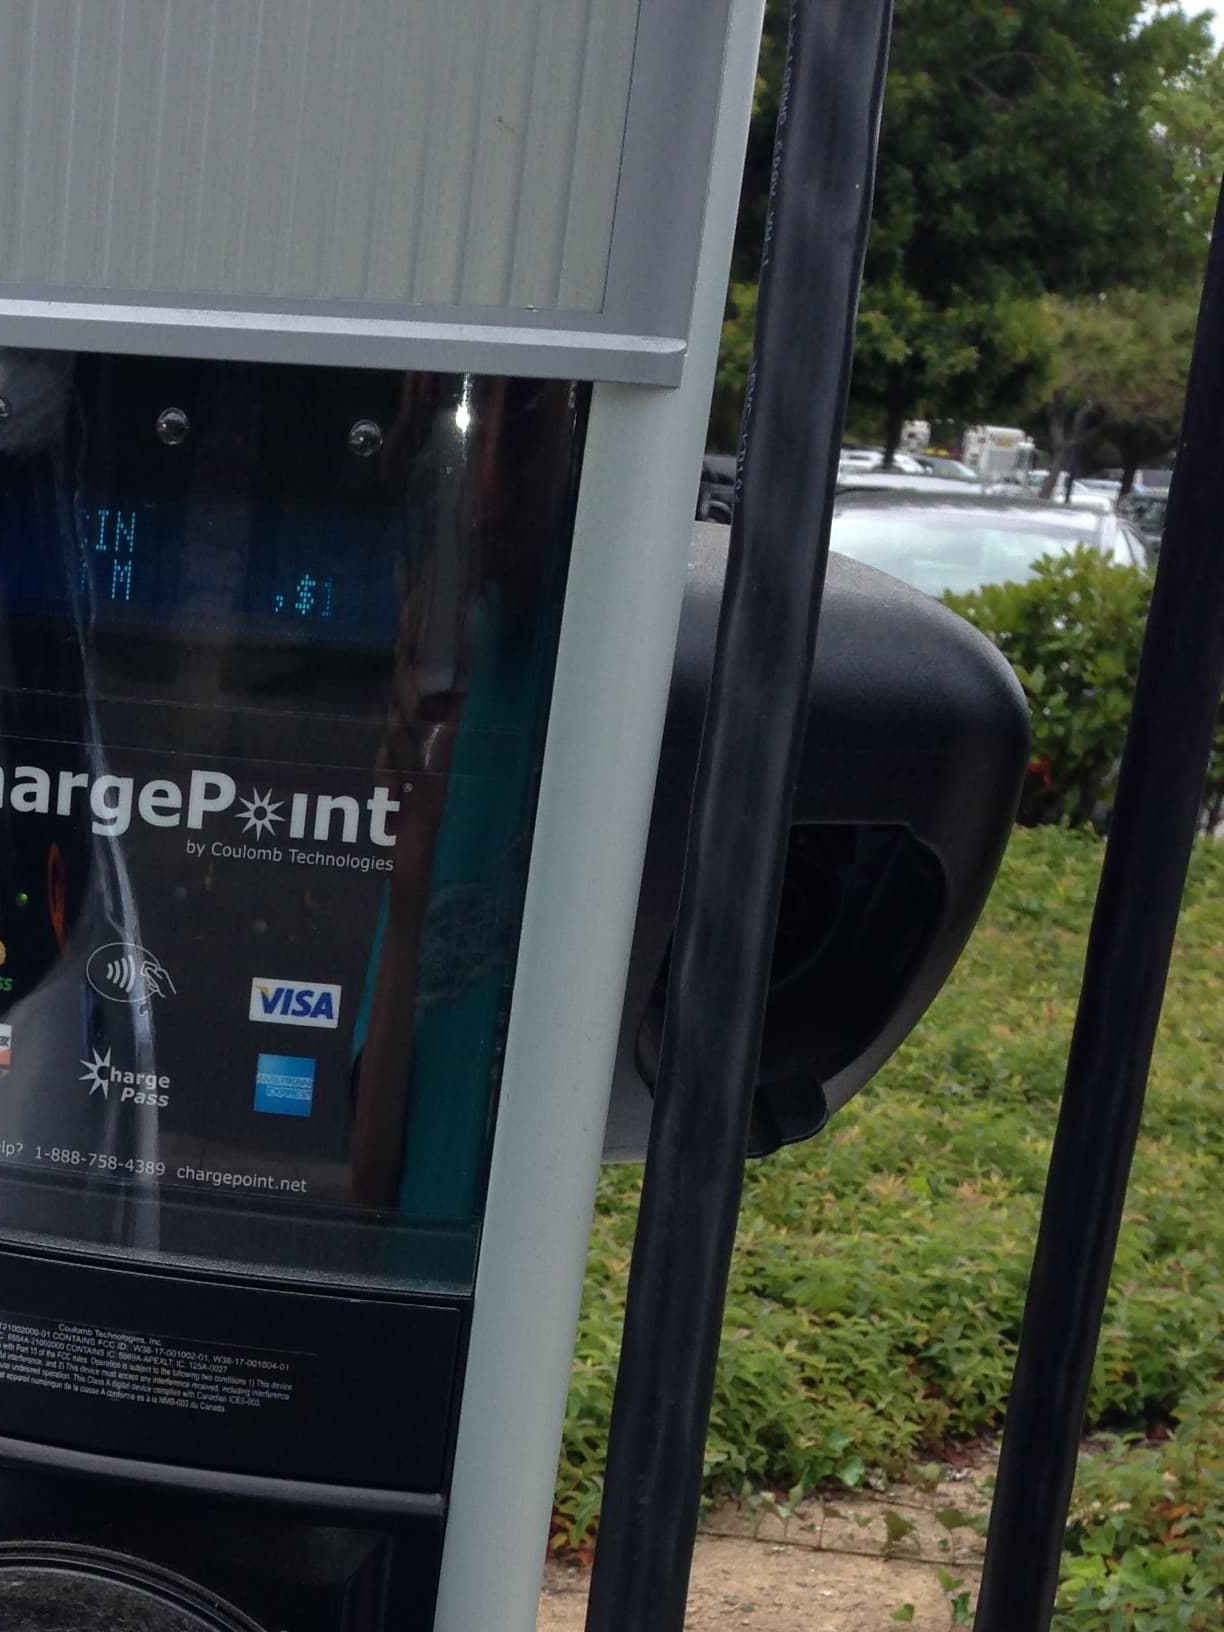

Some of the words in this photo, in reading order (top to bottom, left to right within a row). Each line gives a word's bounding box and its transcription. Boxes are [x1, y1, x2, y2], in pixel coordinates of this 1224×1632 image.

[80, 508, 136, 552] IN
[186, 839, 206, 860] by
[211, 841, 282, 863] Coulomb
[288, 848, 394, 872] Technologies
[258, 986, 334, 1020] VISA
[120, 1087, 169, 1107] Pass
[34, 1146, 166, 1176] 1-888-758-4389
[177, 1165, 307, 1193] chargepoint.net
[52, 1332, 95, 1344] CONTAINS
[58, 1324, 92, 1334] Coulomb
[149, 1337, 162, 1345] Inc.
[66, 1344, 104, 1355] CONTAINS
